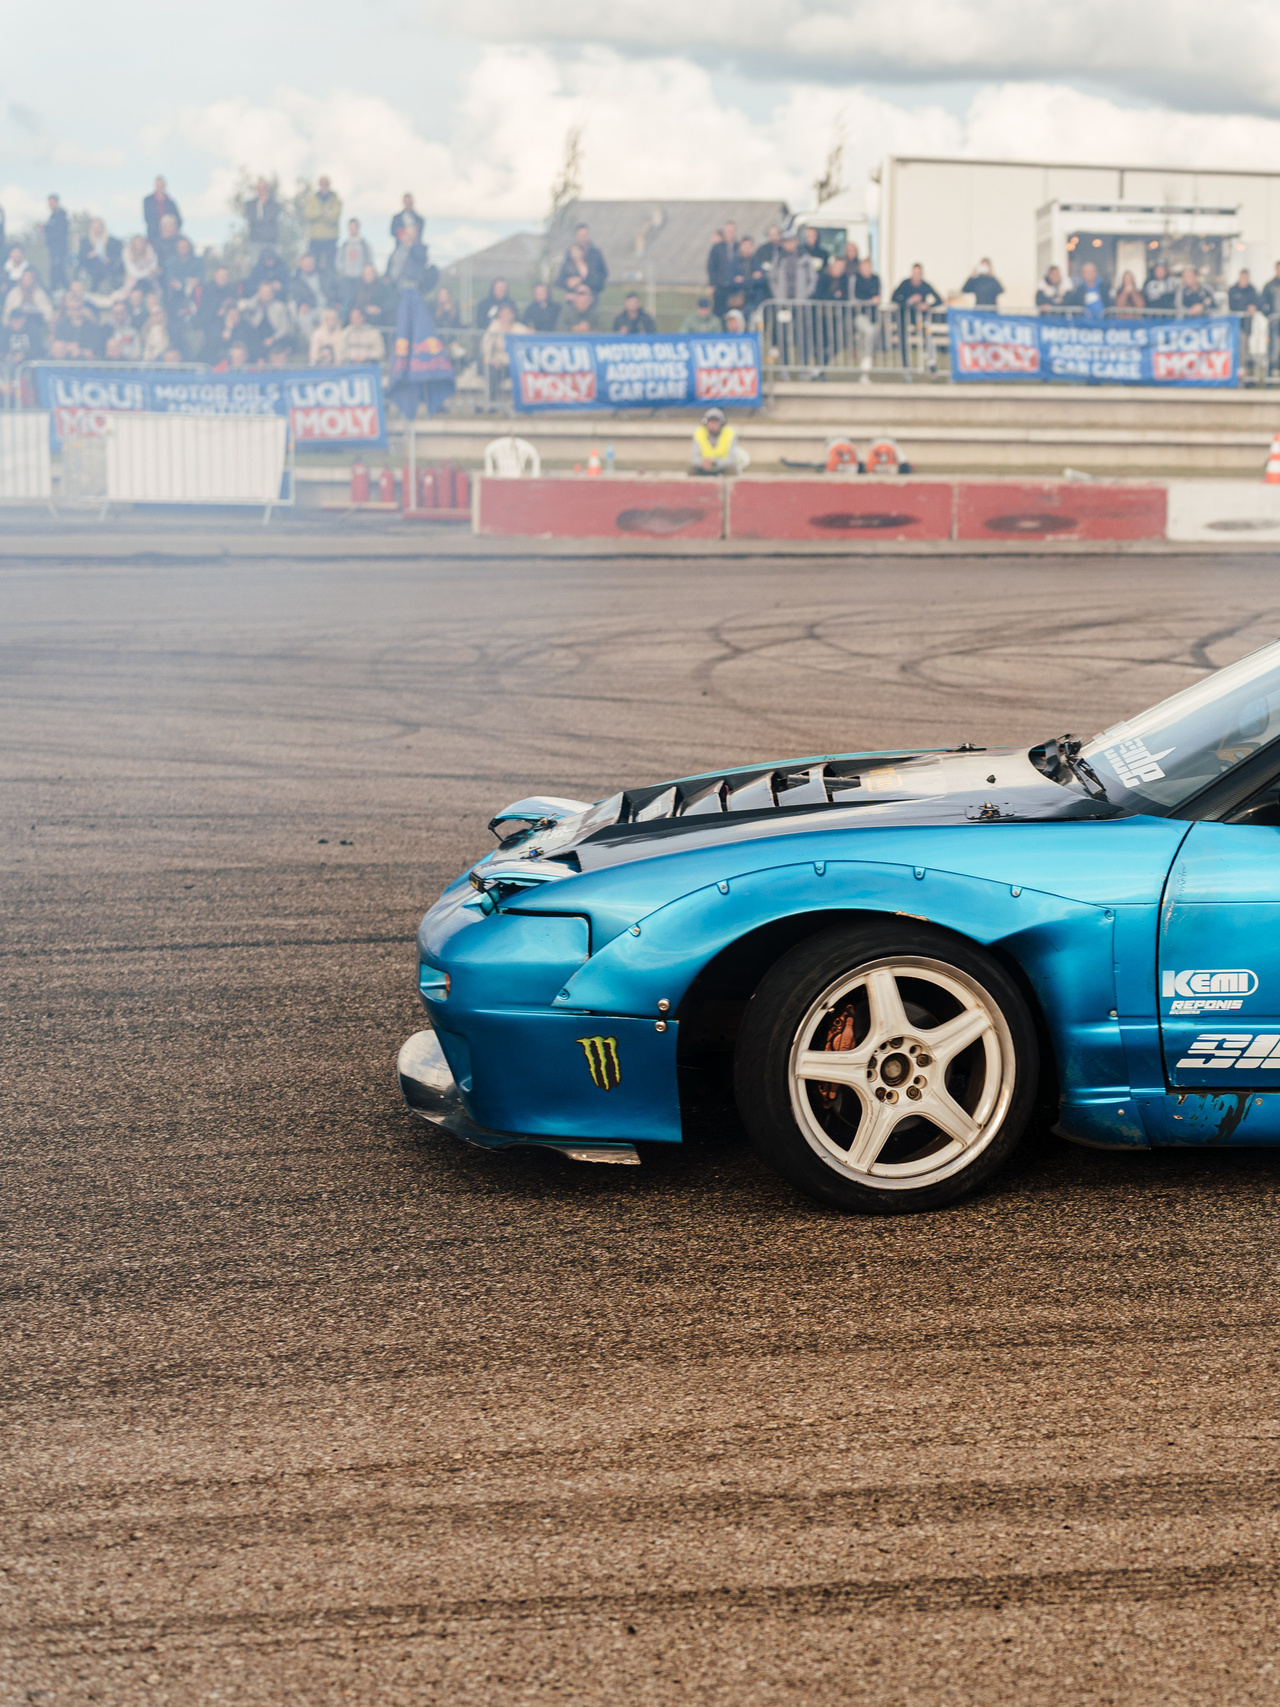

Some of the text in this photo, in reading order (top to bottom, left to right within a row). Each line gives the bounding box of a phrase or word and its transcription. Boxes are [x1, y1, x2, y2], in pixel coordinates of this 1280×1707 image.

[960, 319, 1034, 345] LIQUI
[1040, 328, 1101, 344] MOTOR
[1156, 325, 1228, 351] LIQUI
[523, 346, 591, 373] LIQUI
[597, 343, 690, 361] MOTOR OILS
[698, 341, 755, 367] LIQUI
[963, 344, 1036, 369] MOLY
[1050, 346, 1142, 361] ADDITIVES
[1159, 353, 1228, 376] MOLY
[606, 361, 688, 381] ADDITIVES
[700, 370, 757, 395] MOLY
[1092, 362, 1142, 379] CARE
[291, 379, 372, 406] LIQUI
[526, 373, 594, 399] MOLY
[609, 381, 688, 401] CAR CARE
[295, 408, 374, 436] MOLY
[1171, 1000, 1243, 1010] REPONIS
